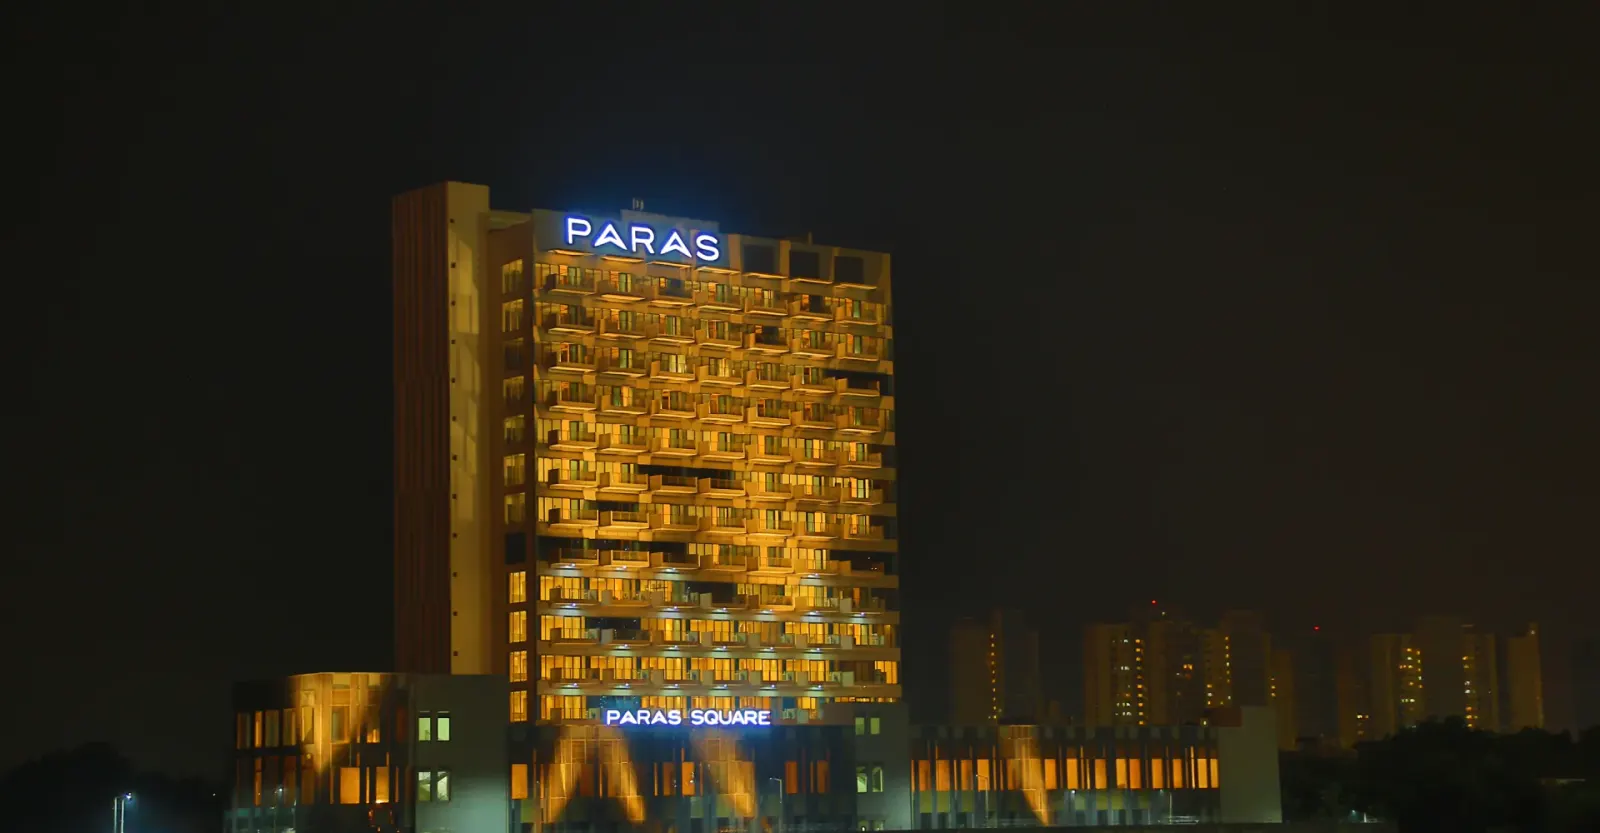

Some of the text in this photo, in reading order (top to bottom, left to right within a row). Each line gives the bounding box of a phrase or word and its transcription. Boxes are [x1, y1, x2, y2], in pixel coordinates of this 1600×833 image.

[567, 217, 720, 261] PARAS
[606, 709, 771, 726] PARAS SQUARE
